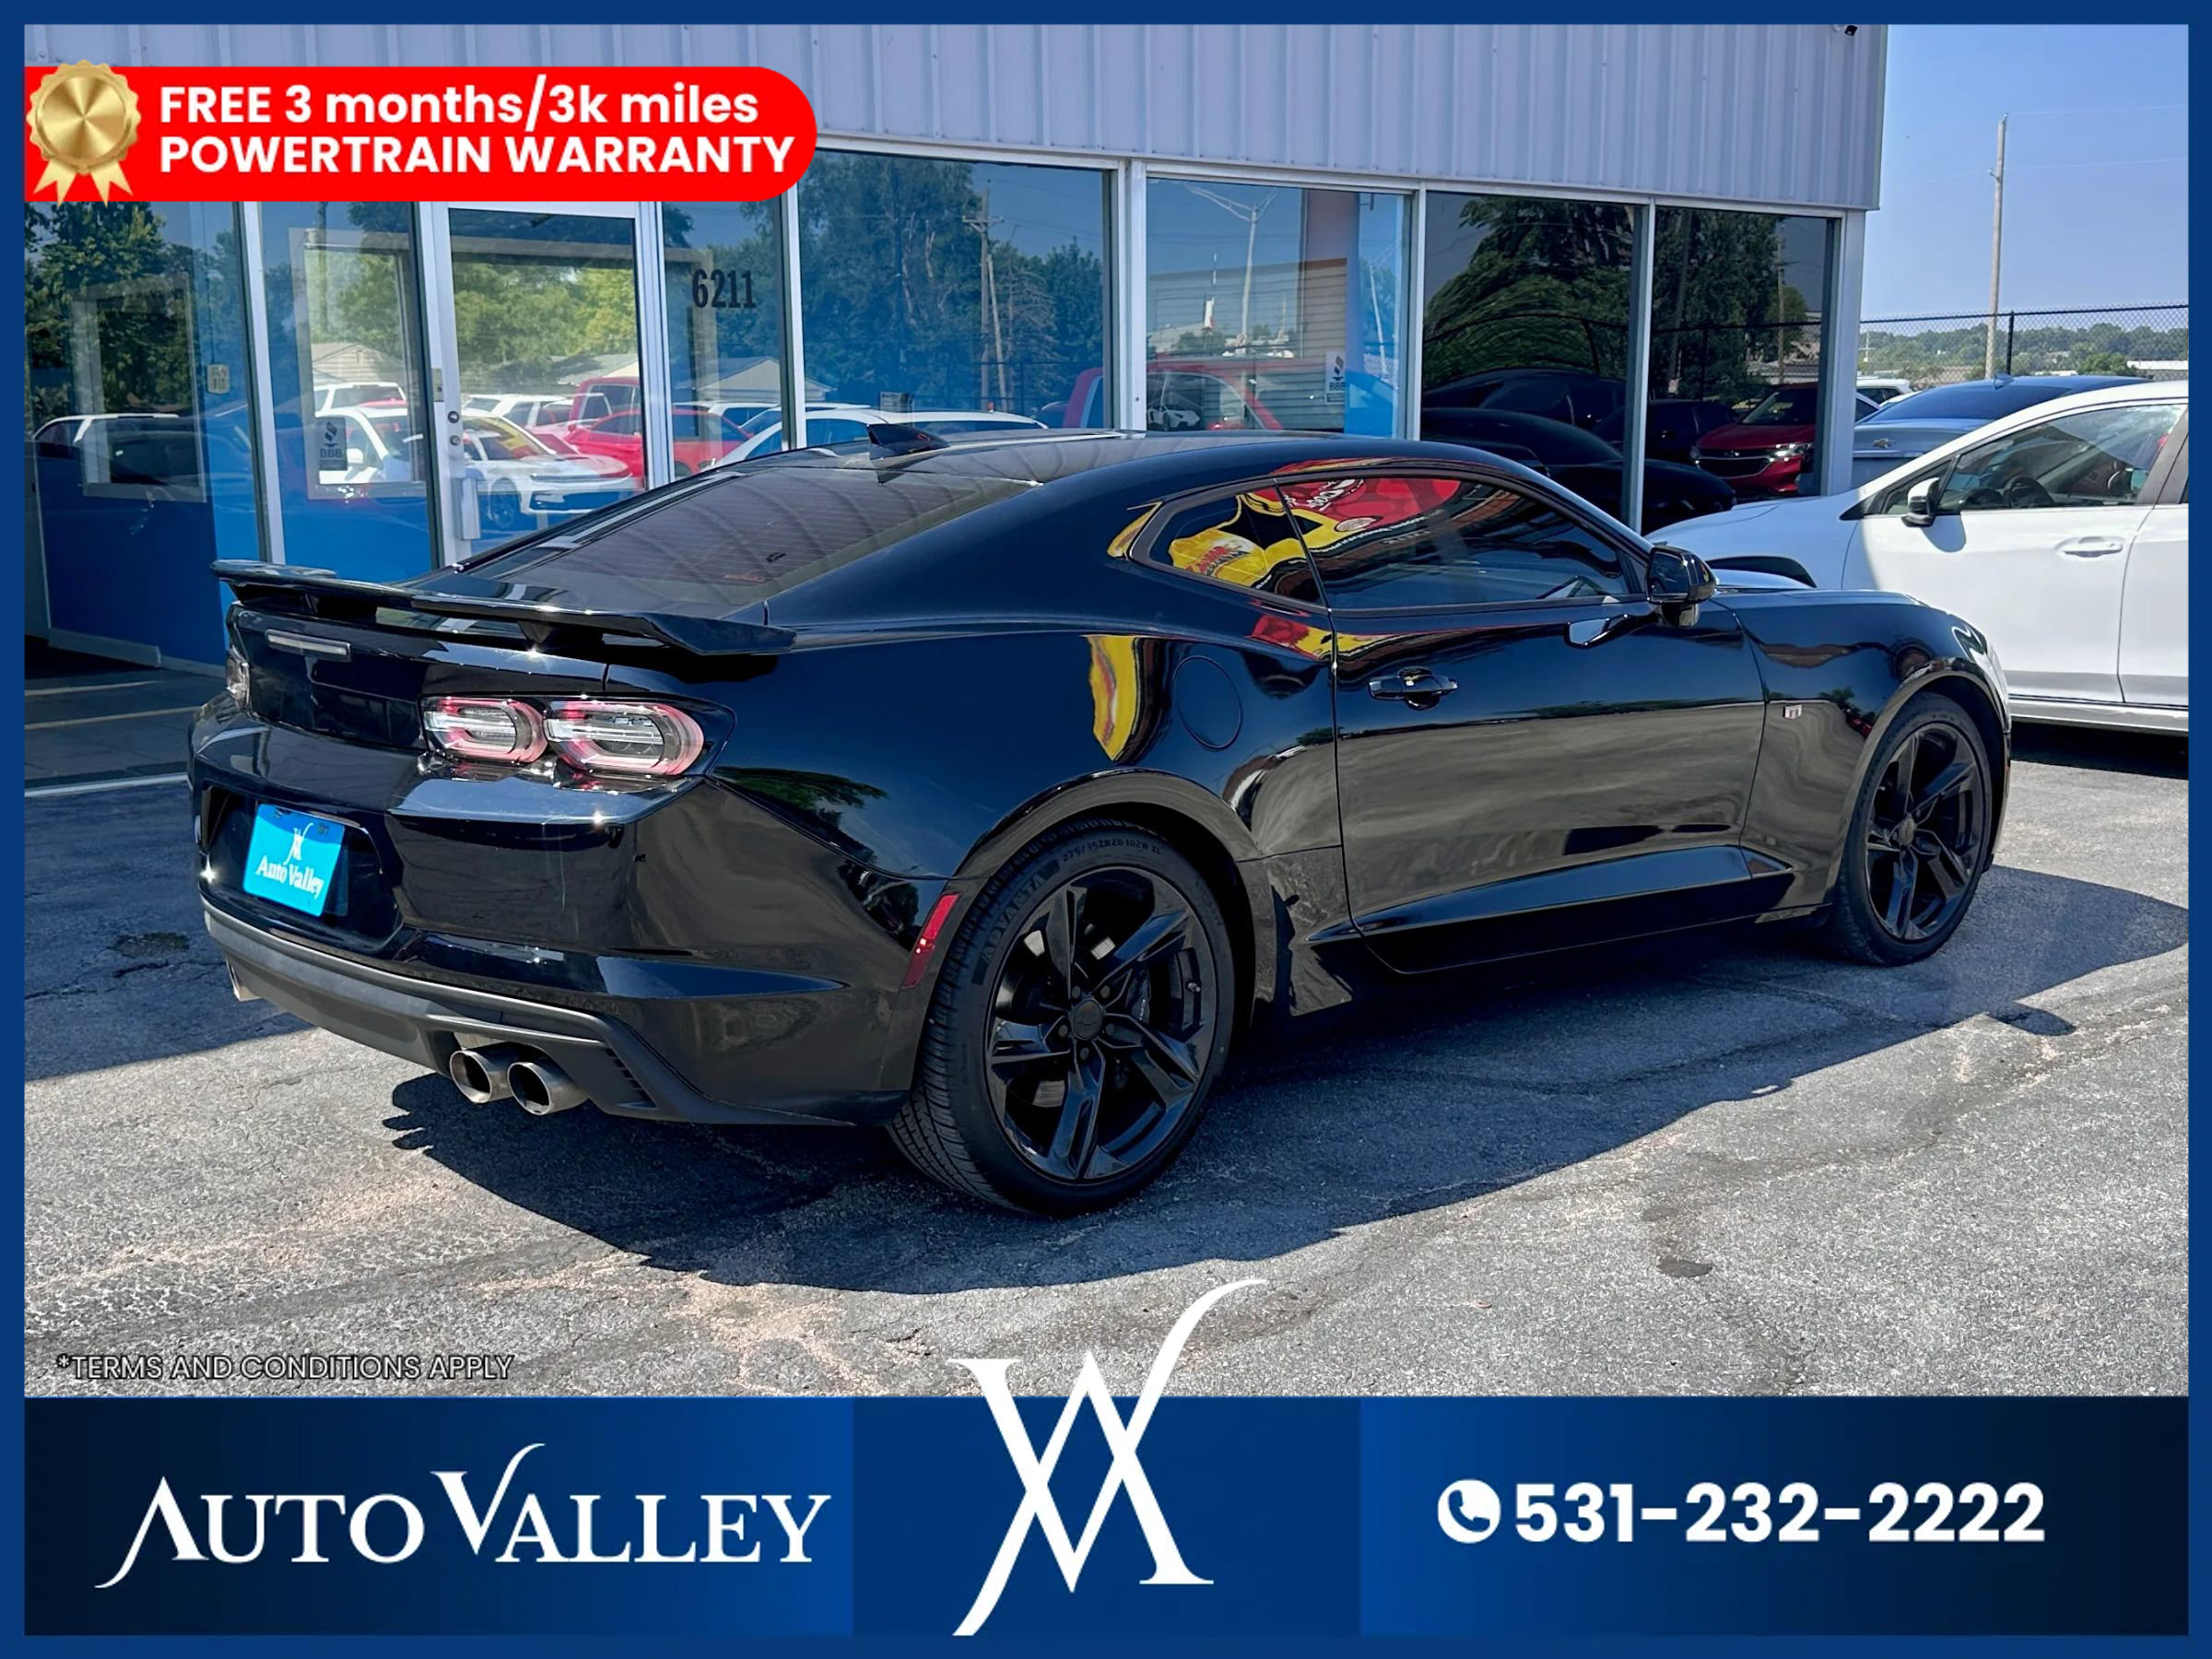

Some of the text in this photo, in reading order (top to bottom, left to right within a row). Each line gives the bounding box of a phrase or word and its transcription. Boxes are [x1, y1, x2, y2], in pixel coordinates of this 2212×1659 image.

[692, 268, 756, 309] 6211
[255, 854, 324, 900] Auto Valley
